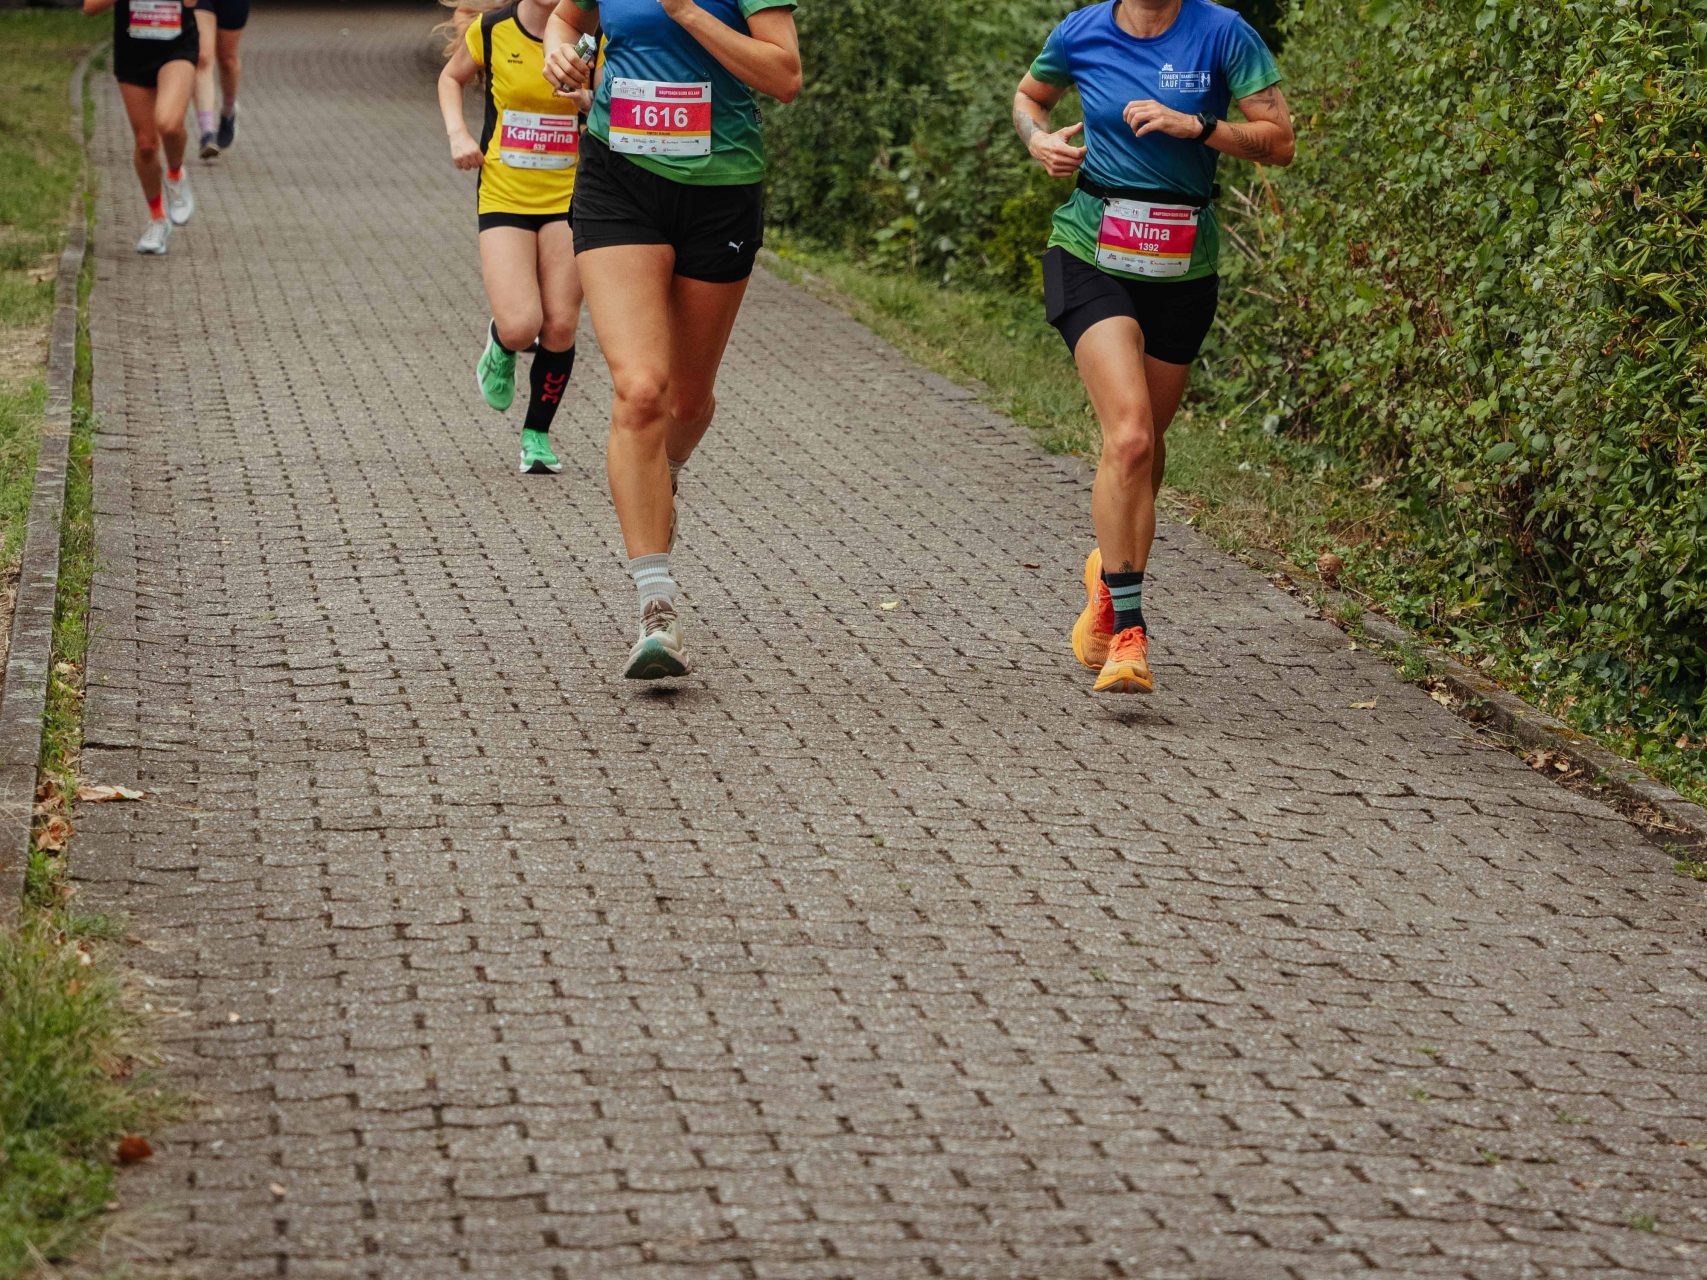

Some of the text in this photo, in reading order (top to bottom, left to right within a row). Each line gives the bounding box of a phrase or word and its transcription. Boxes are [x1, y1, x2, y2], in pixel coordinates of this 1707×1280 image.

[1161, 80, 1179, 88] LAUF
[631, 104, 688, 128] 1616
[507, 126, 573, 144] Katharina
[1129, 222, 1171, 241] Nina
[1138, 242, 1159, 252] 1392
